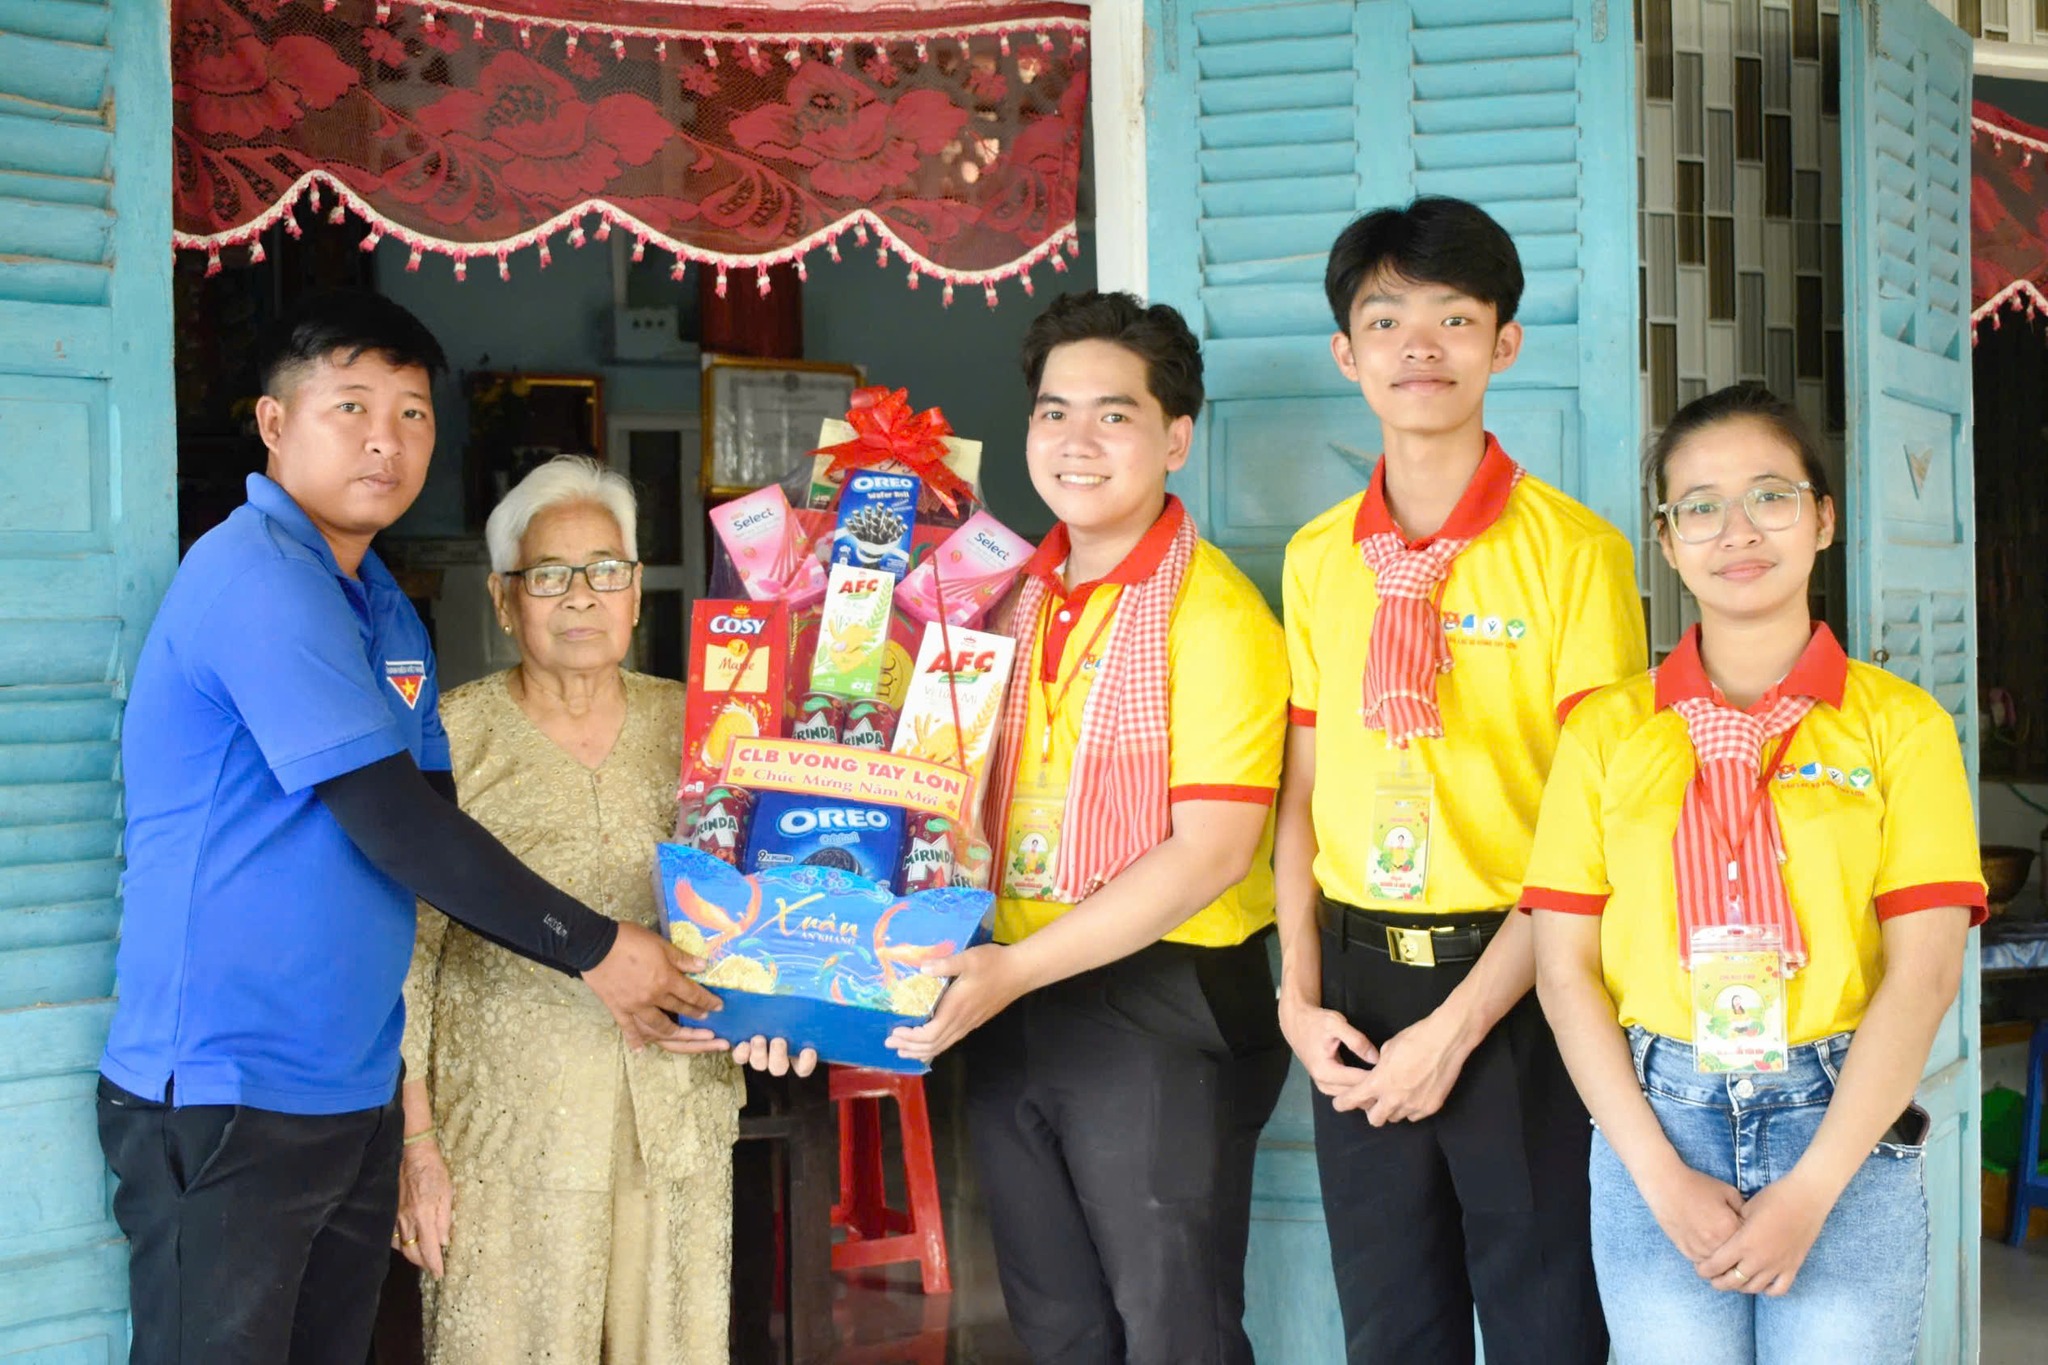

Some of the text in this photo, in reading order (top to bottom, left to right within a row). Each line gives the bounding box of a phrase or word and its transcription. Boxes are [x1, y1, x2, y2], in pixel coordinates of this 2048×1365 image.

[853, 476, 913, 491] OREO
[733, 508, 774, 531] Select
[974, 532, 1009, 561] Select
[838, 578, 879, 594] AFC
[709, 615, 766, 635] COSY
[925, 650, 996, 673] AFC
[738, 748, 780, 763] CLB
[867, 762, 906, 780] TAY
[753, 769, 796, 783] Chúc
[779, 808, 889, 835] OREO
[750, 892, 858, 938] Xuân
